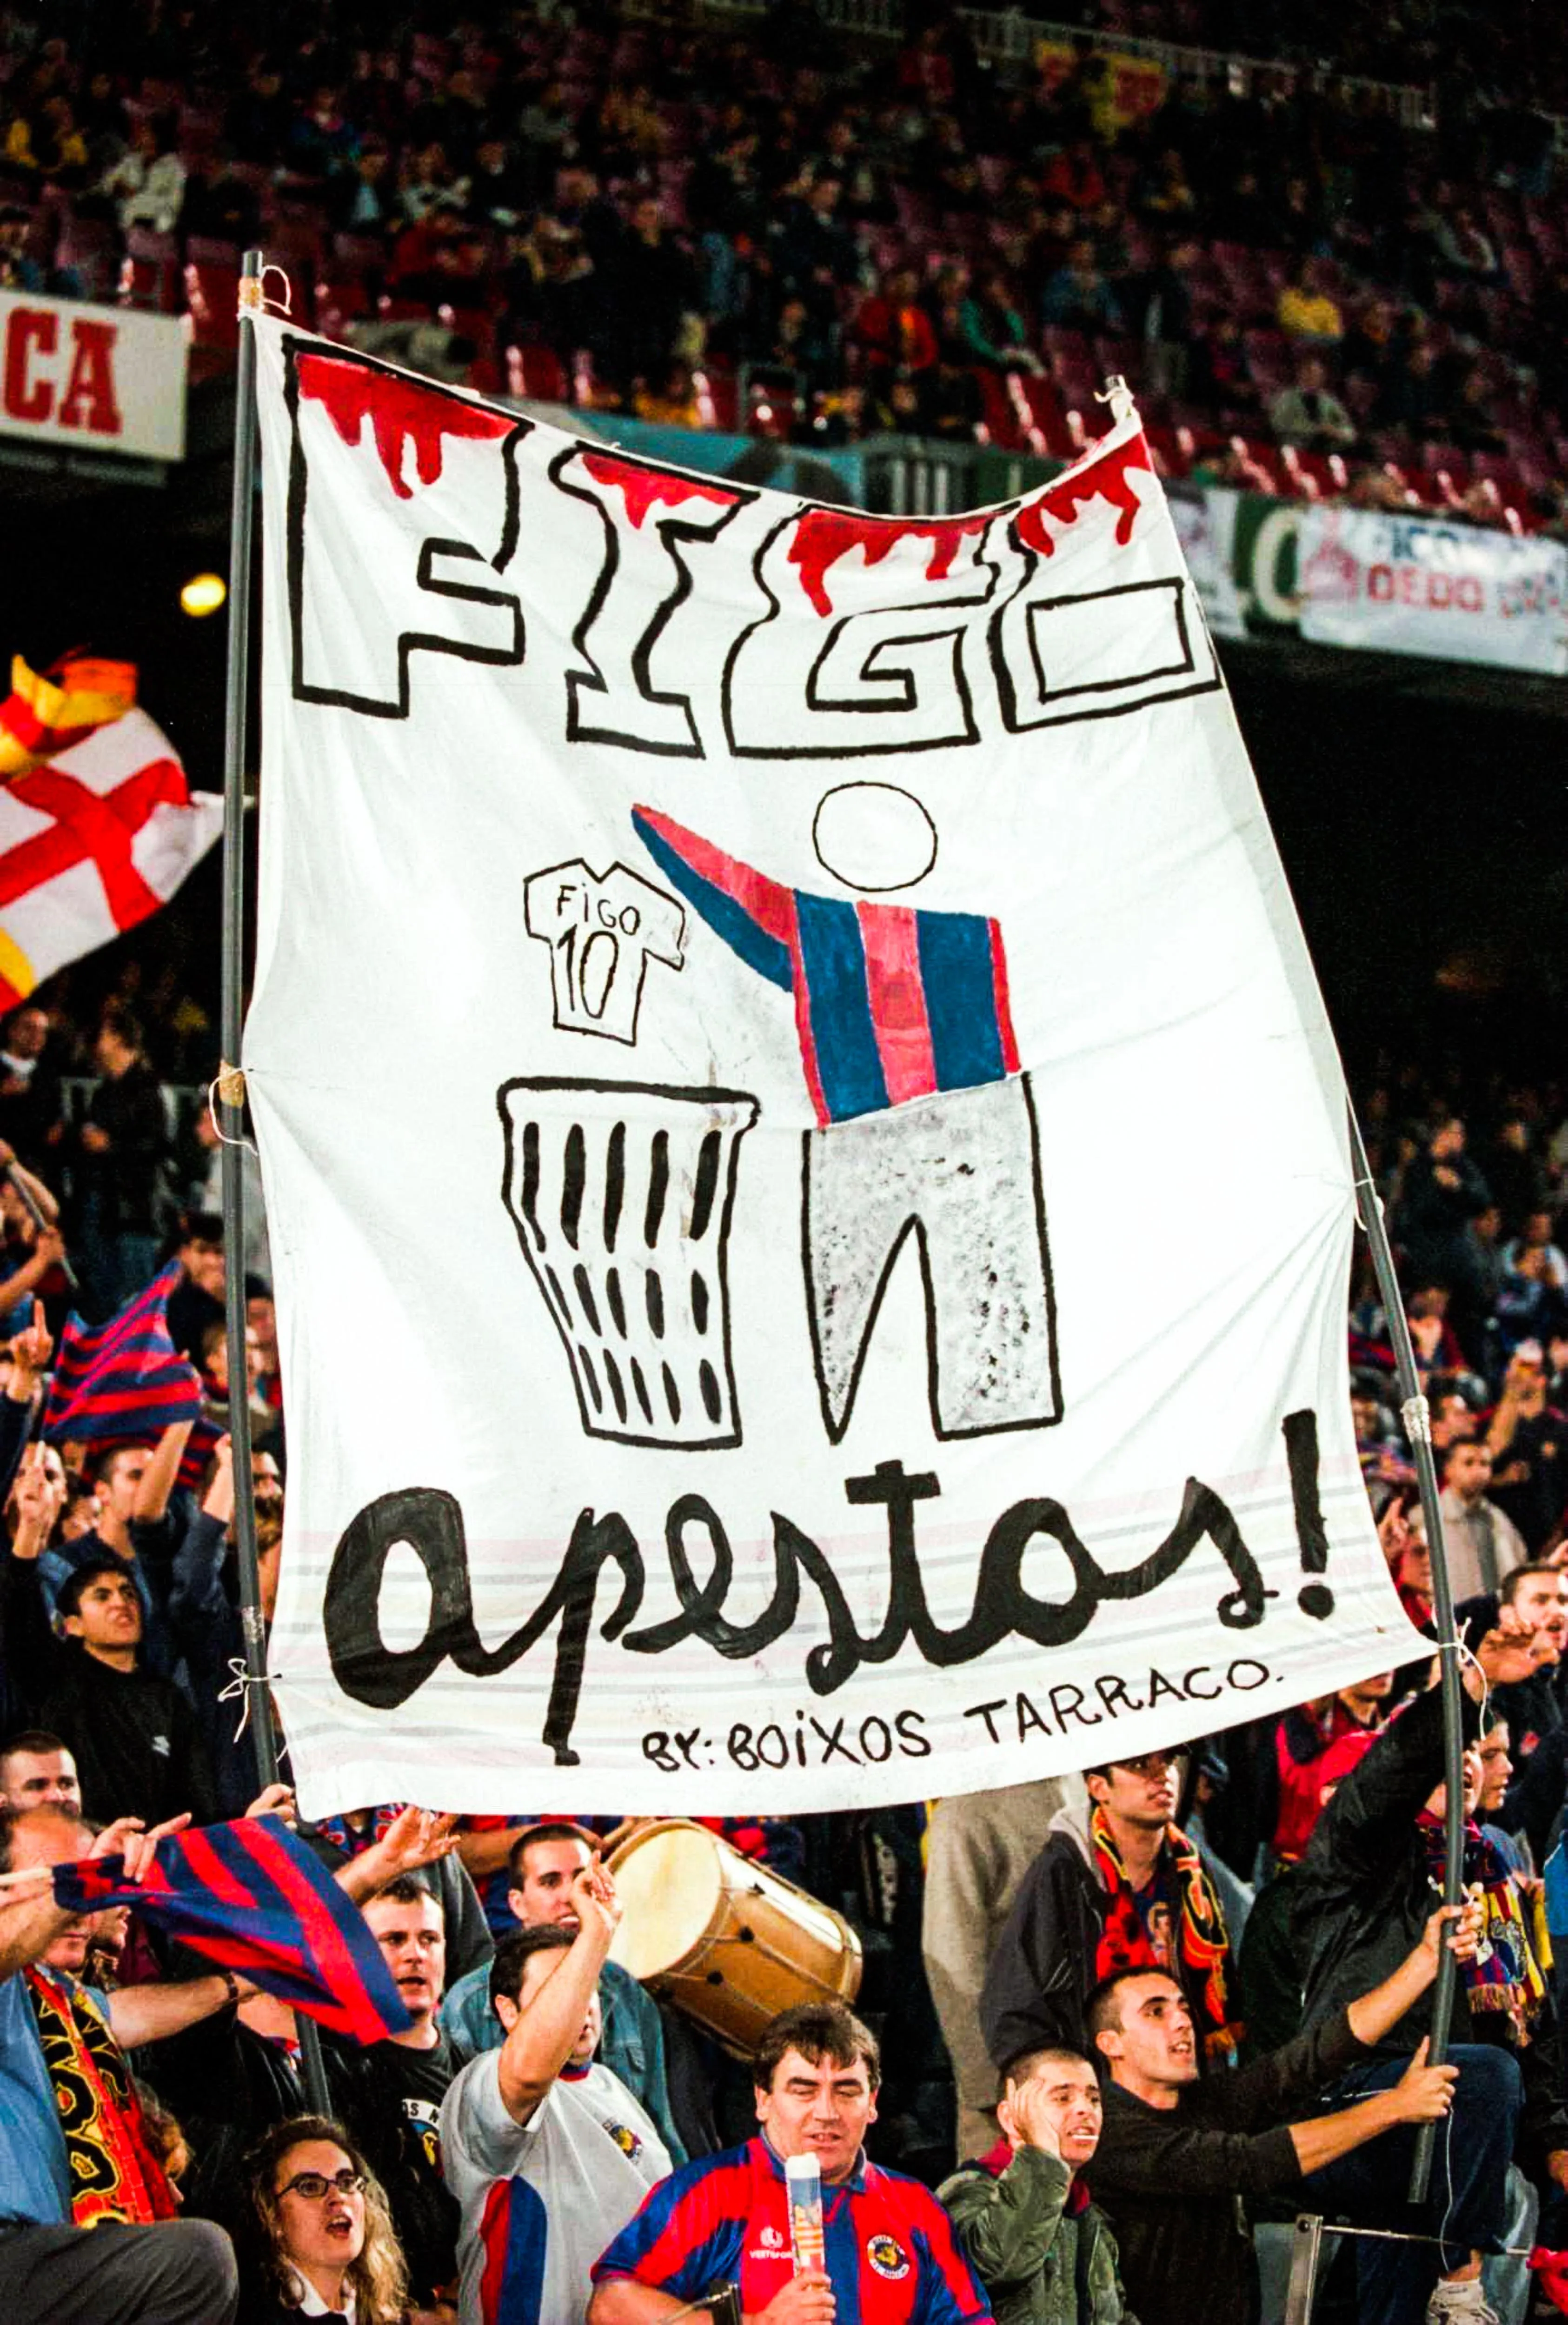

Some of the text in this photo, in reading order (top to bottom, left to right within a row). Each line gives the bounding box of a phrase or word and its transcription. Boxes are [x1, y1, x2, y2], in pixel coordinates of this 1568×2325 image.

[4, 306, 124, 436] CA
[281, 332, 1224, 761] FIGO
[557, 923, 619, 1019] 10
